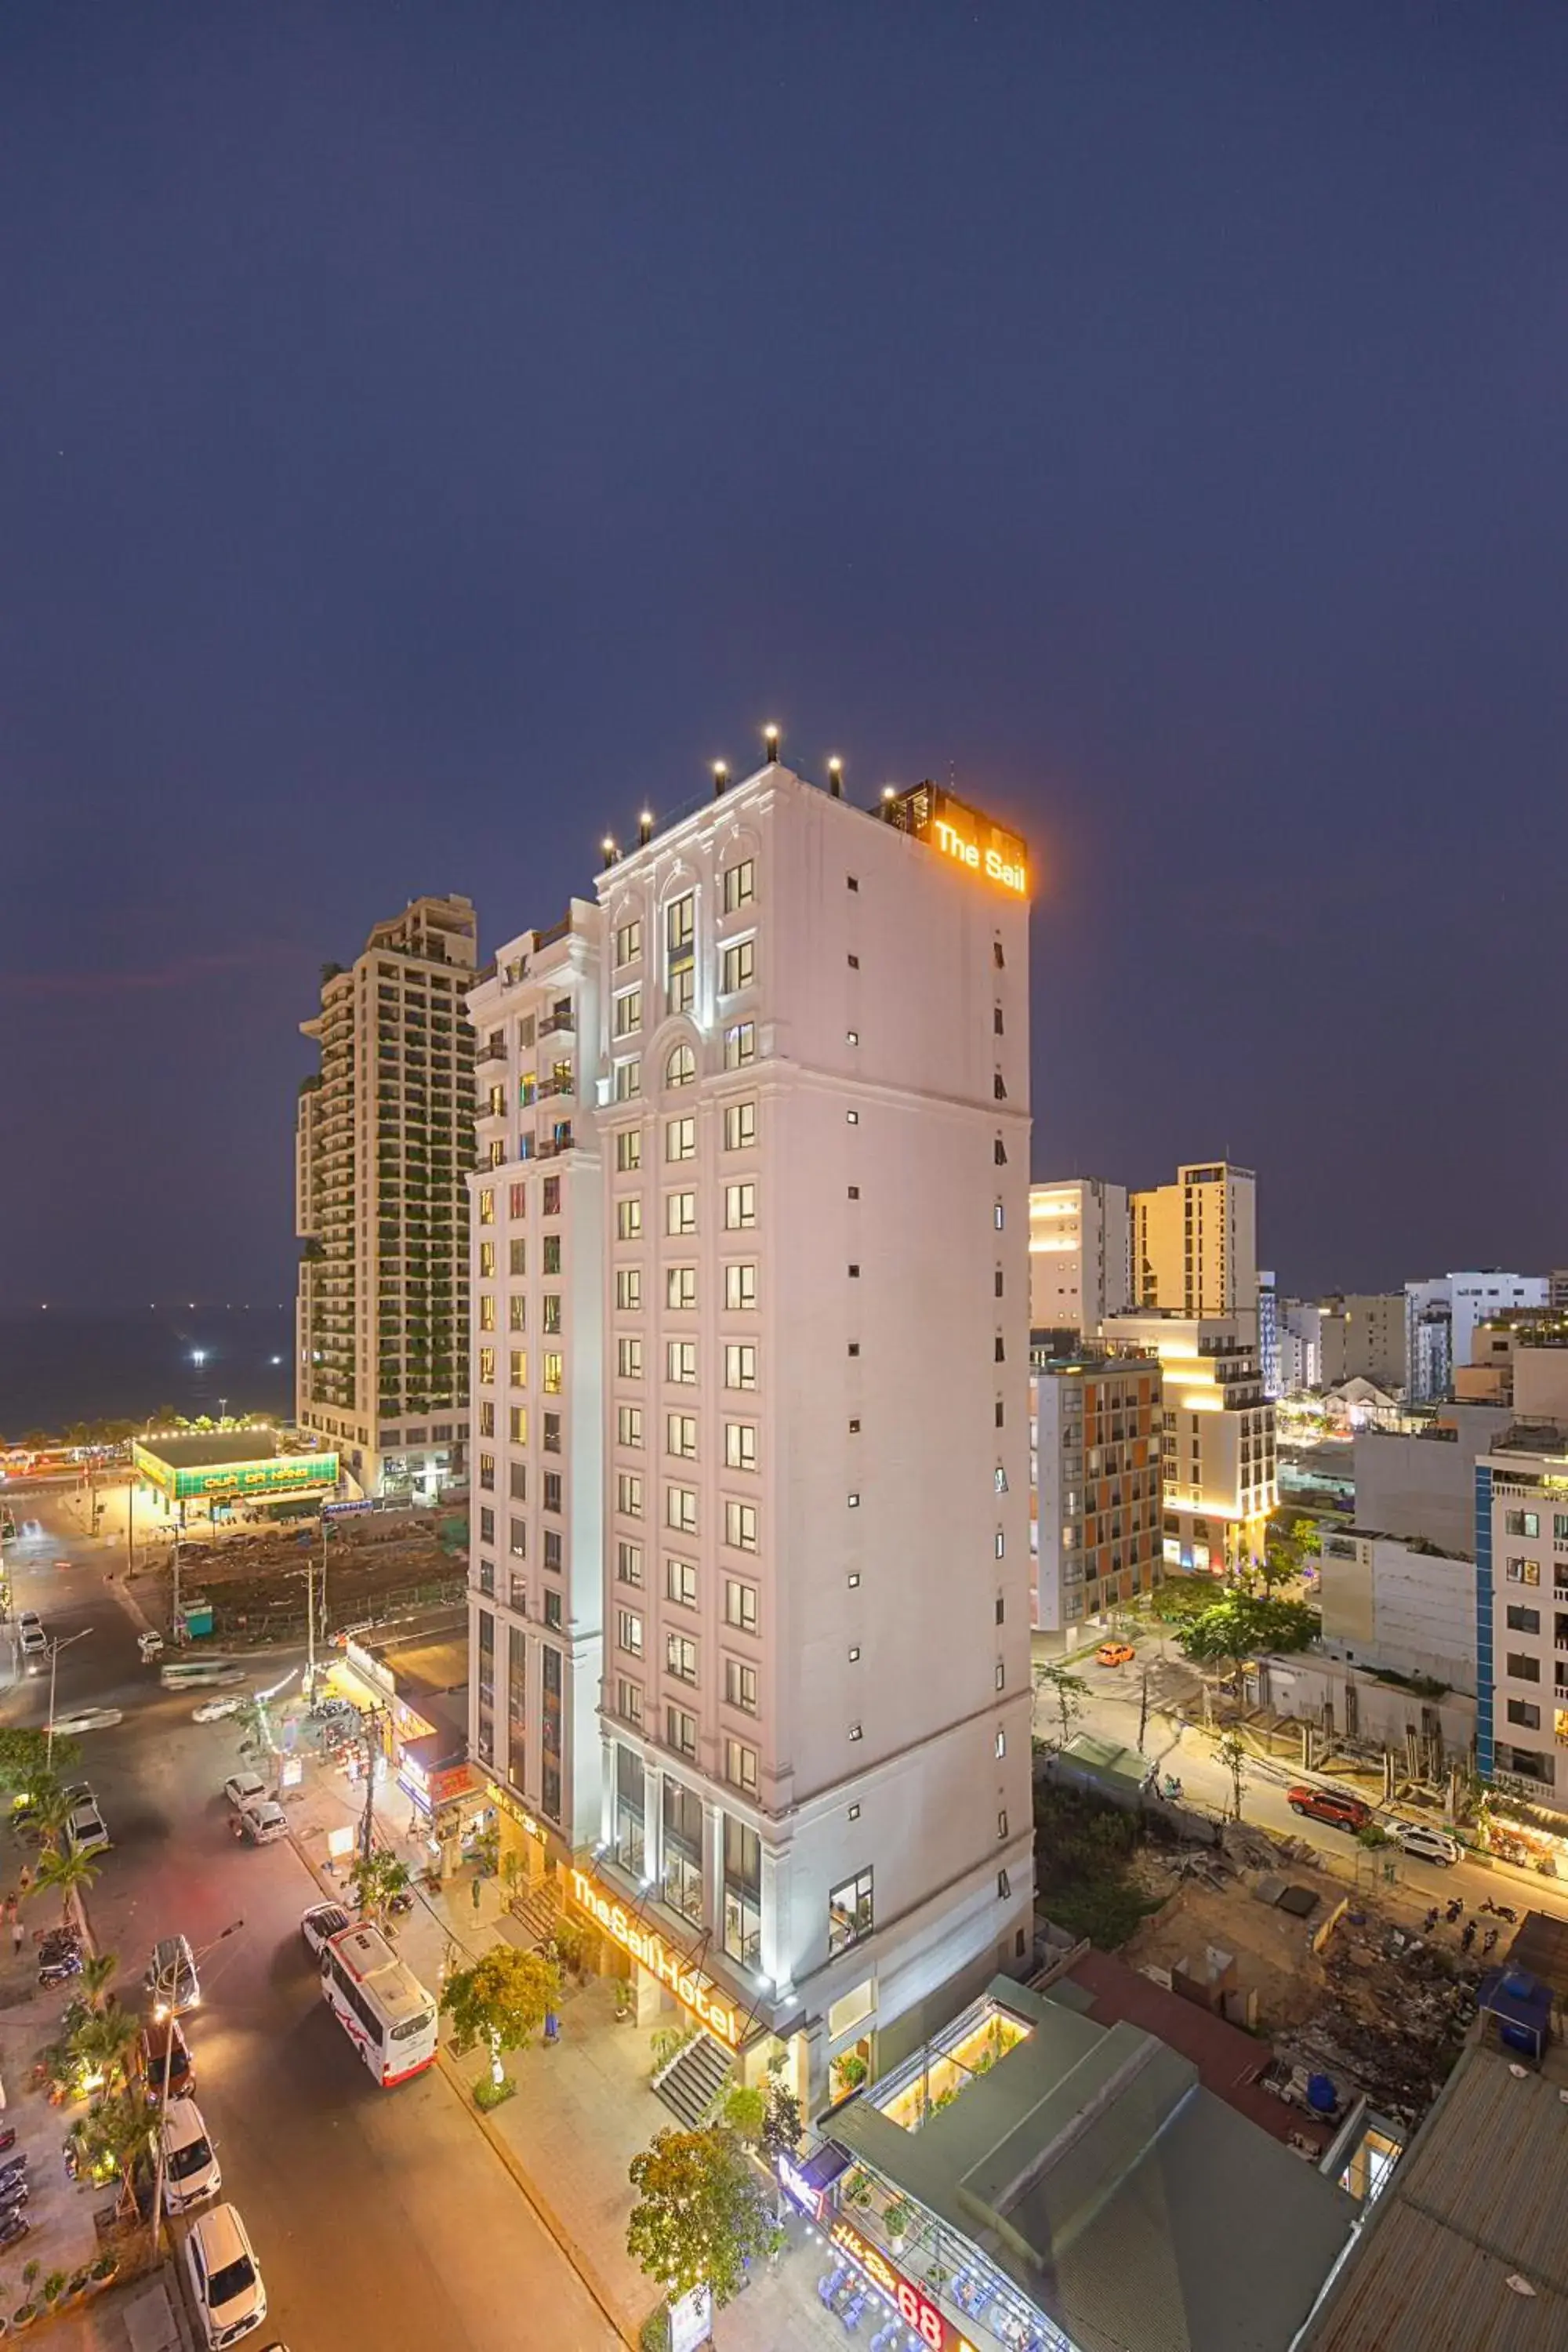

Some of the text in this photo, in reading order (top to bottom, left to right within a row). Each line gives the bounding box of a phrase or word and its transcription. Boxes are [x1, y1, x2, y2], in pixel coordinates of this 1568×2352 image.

[935, 820, 1025, 892] The Sail
[571, 1869, 737, 2045] The Sail Hotel
[898, 2283, 942, 2350] 68
